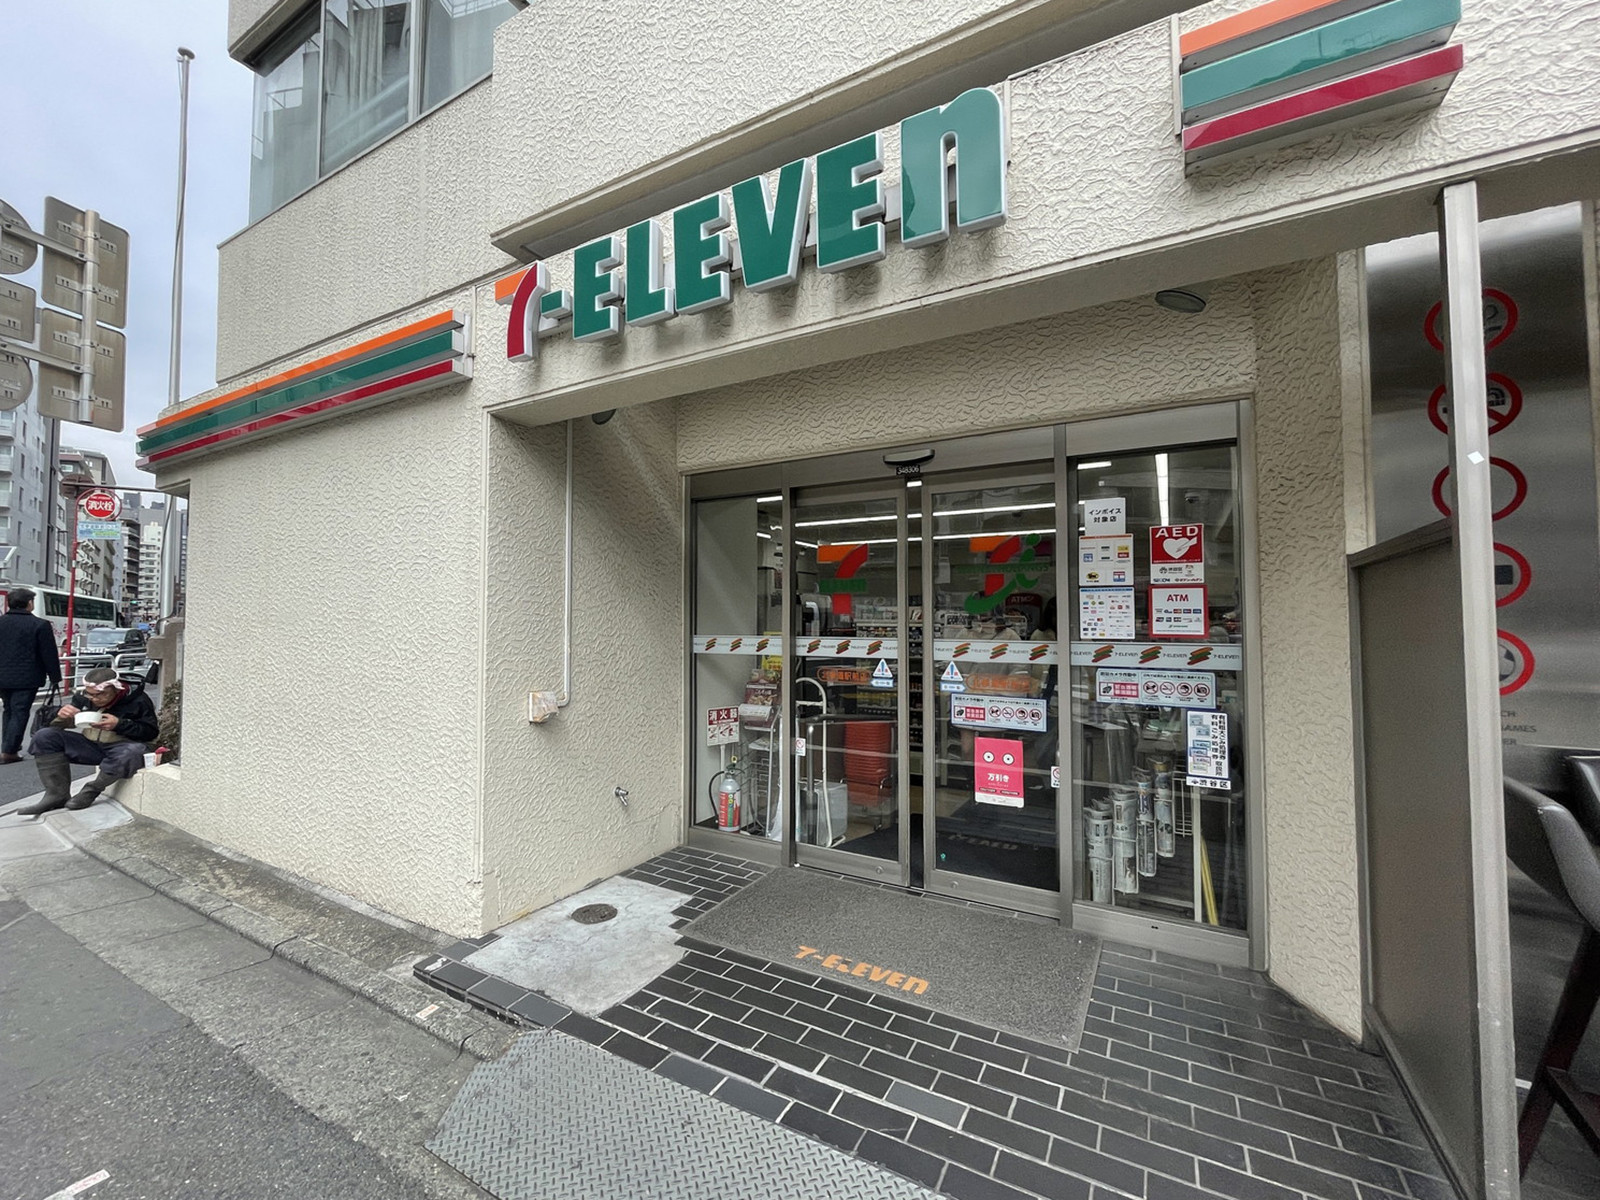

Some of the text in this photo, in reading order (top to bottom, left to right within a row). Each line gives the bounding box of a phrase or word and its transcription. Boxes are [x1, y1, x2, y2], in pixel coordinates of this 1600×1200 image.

[88, 500, 114, 511] 消火栓
[1155, 526, 1198, 538] AED
[1167, 594, 1189, 602] ATM
[709, 708, 738, 720] 消火器
[988, 773, 1009, 783] 万引き
[1200, 779, 1228, 788] 渋谷区
